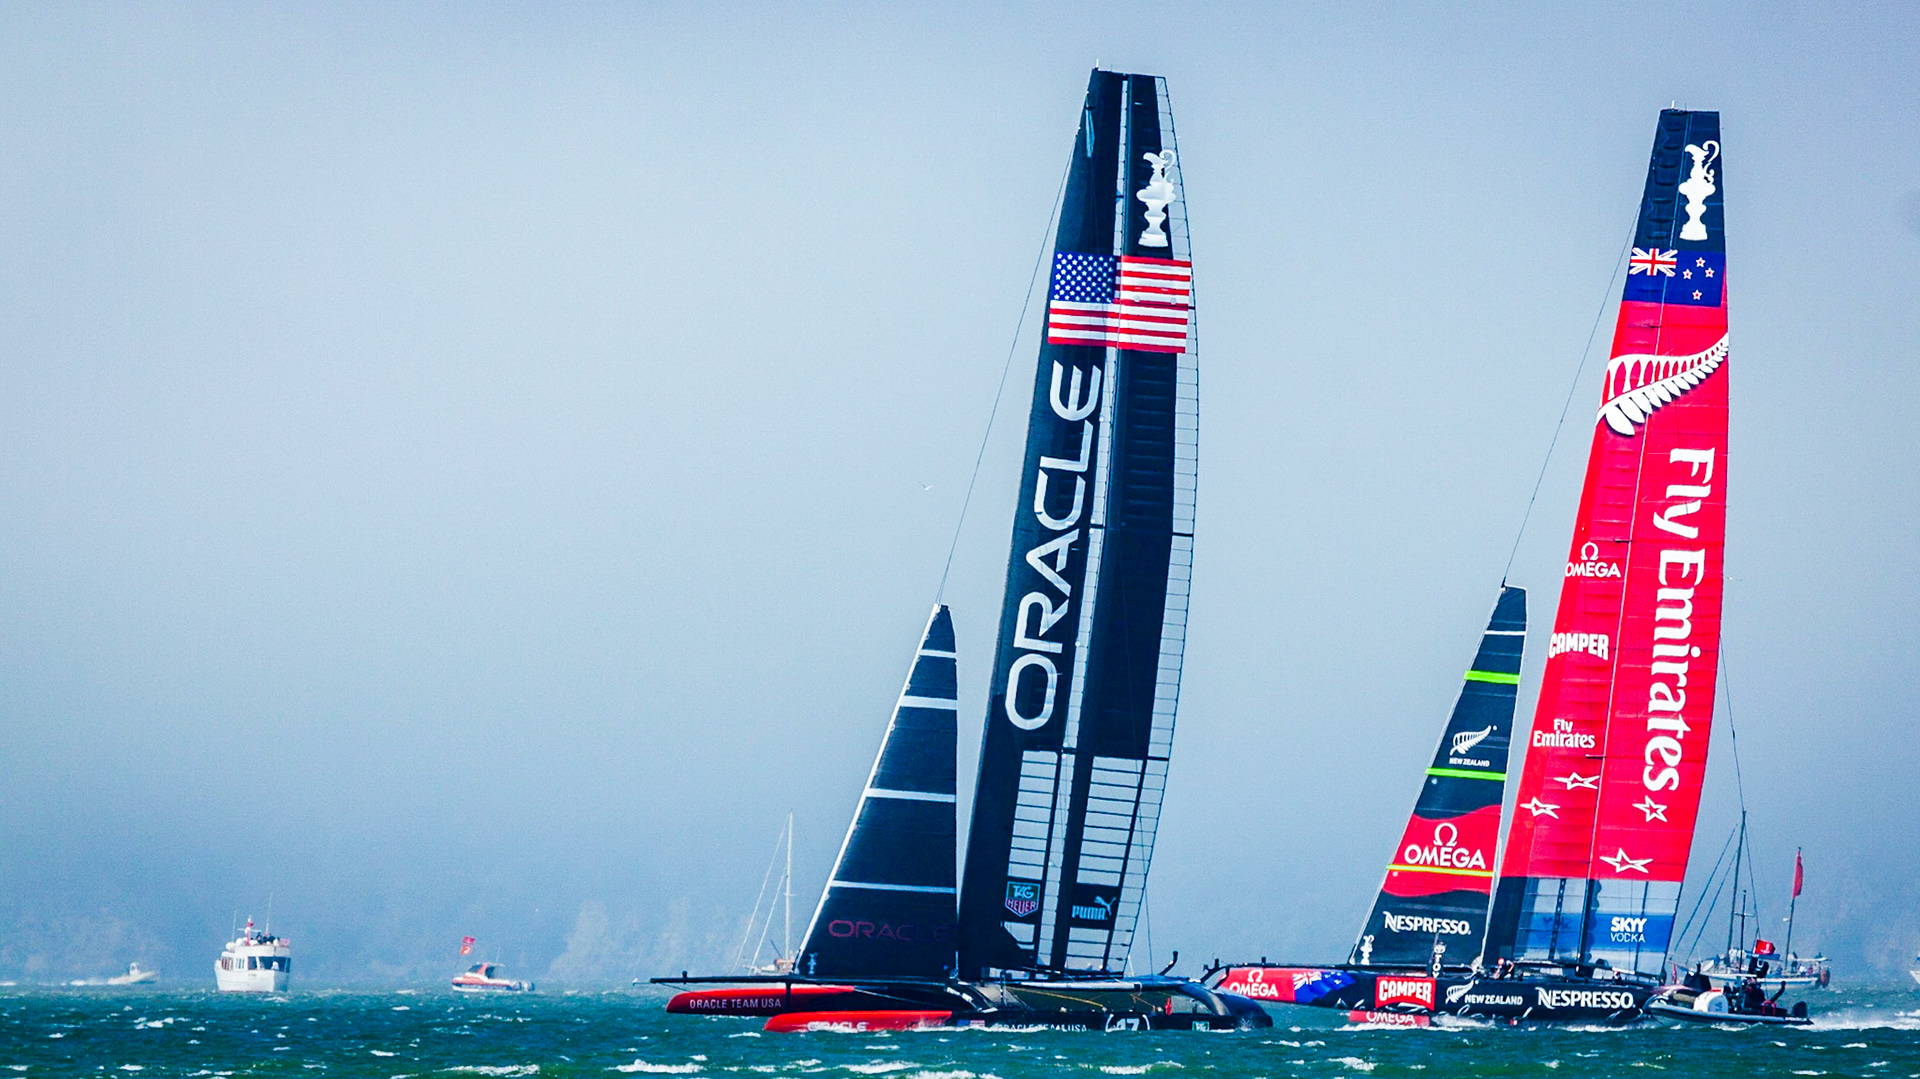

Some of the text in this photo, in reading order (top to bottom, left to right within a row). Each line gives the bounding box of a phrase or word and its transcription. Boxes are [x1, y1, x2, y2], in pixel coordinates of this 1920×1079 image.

[1005, 360, 1101, 731] ORACLE
[1565, 562, 1621, 578] OMEGA
[1643, 447, 1715, 791] Fly Emirates
[1549, 633, 1609, 660] CAMPER
[1554, 719, 1573, 731] Fly
[1533, 730, 1595, 748] Emirates
[1463, 758, 1490, 767] ZEALAND
[1404, 845, 1486, 869] OMEGA
[1013, 885, 1034, 899] TAG
[1007, 899, 1036, 915] HEUER
[828, 919, 949, 942] ORACLE
[1383, 911, 1471, 935] NESPRESSO
[1611, 917, 1647, 933] SKYY
[1610, 933, 1646, 942] VODKA
[1229, 983, 1279, 997] OMEGA
[1378, 980, 1431, 1001] CAMPER
[1535, 987, 1636, 1009] NESPRESSO
[689, 999, 781, 1009] ORACLE TEAM USA
[1464, 994, 1523, 1005] NEW ZEALAND
